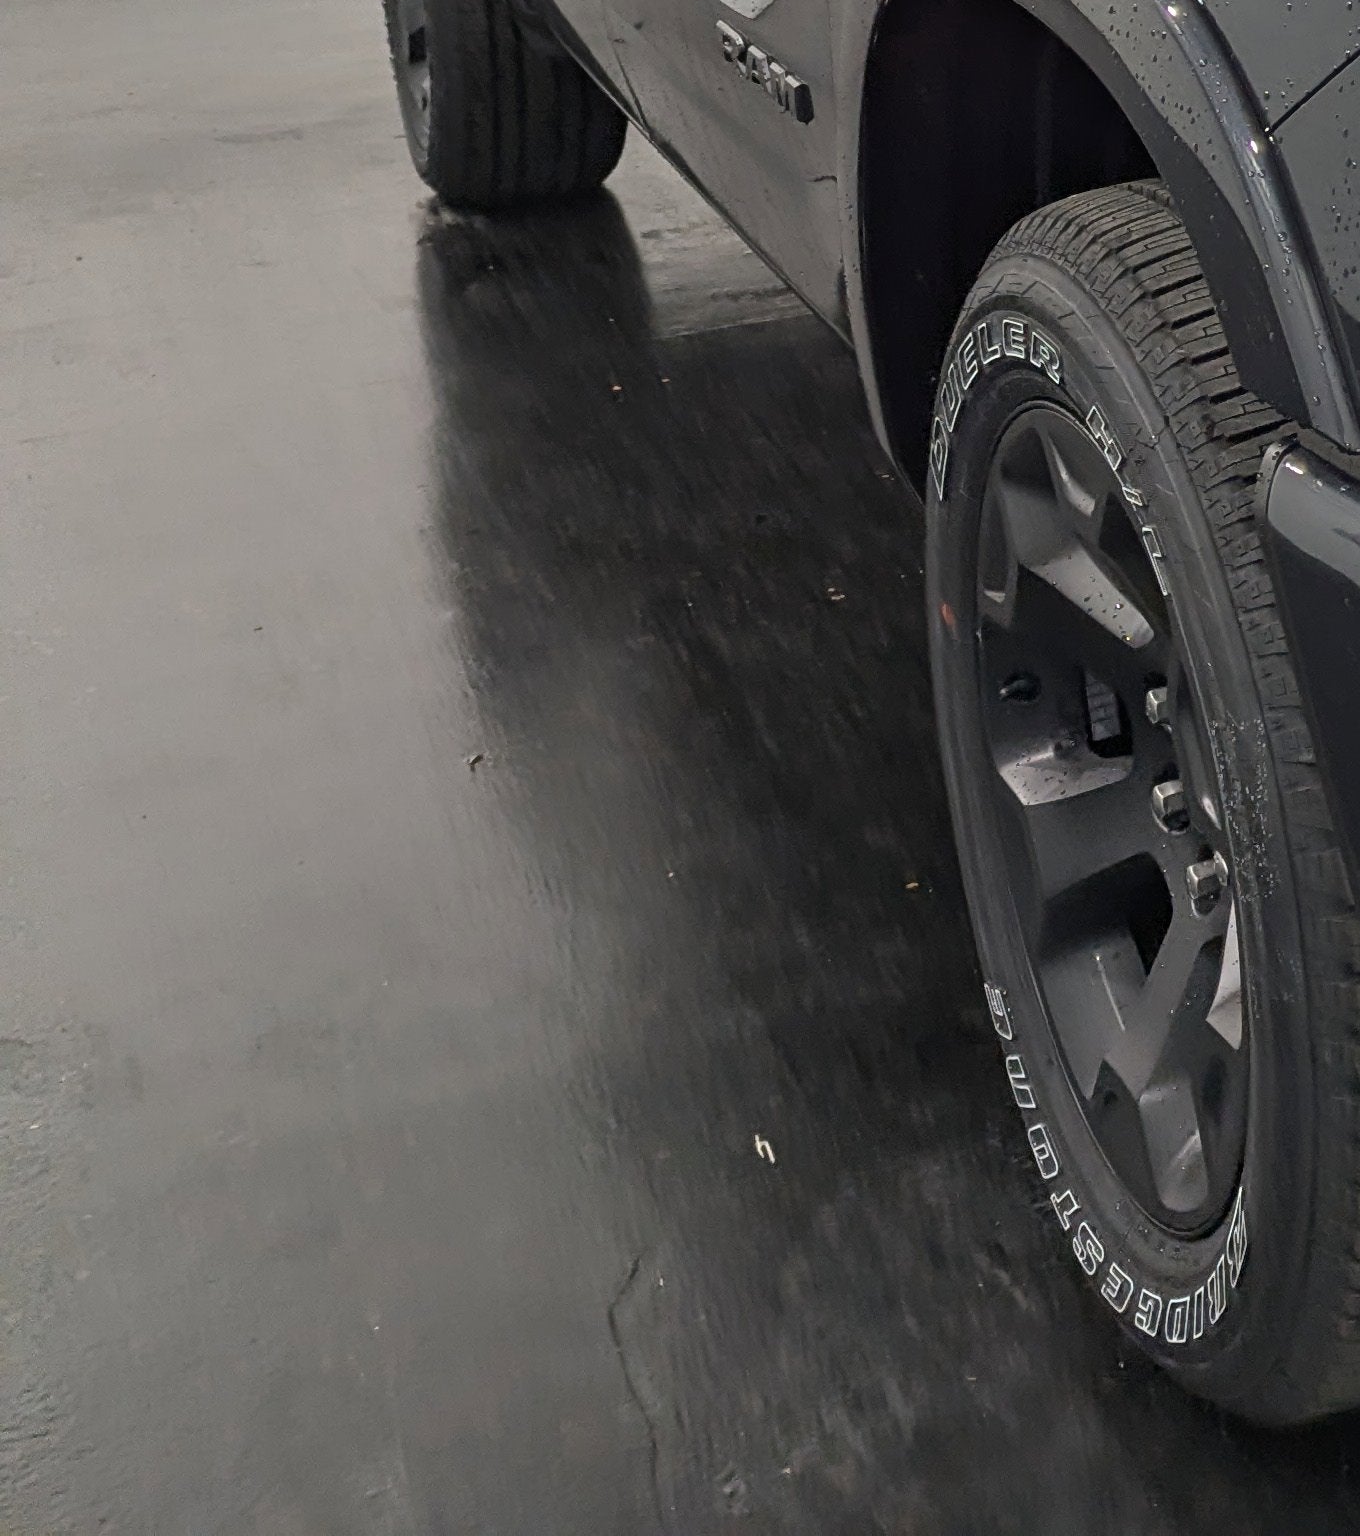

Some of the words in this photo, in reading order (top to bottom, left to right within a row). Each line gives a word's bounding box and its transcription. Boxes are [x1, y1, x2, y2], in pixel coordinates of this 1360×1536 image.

[716, 20, 814, 125] RAM
[929, 319, 1061, 501] DUELER
[984, 983, 1248, 1344] BRIDGESTONE
